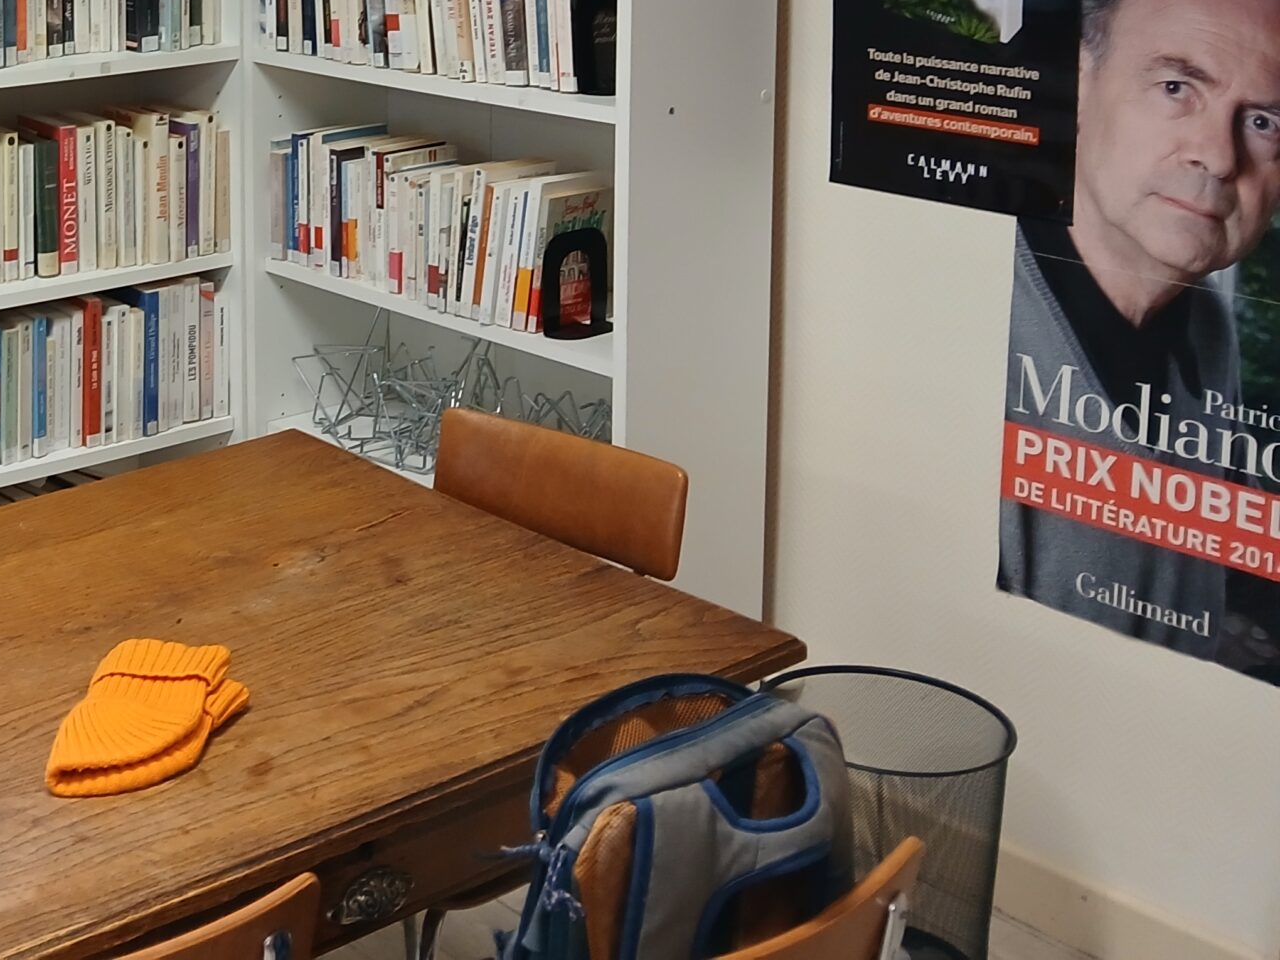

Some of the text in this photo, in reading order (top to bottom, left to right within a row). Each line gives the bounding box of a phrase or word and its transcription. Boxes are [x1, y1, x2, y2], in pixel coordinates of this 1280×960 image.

[488, 24, 496, 58] STEFAN
[867, 48, 1040, 81] Toute la puissance narrative
[875, 68, 1032, 100] de Jean-Christophe Rufin
[870, 107, 1038, 142] d'aventures contemporain.
[886, 90, 1018, 119] dans un grand roman
[907, 153, 988, 178] CALMANN
[157, 155, 167, 221] Jean Moulin
[63, 179, 76, 254] MONET
[188, 324, 197, 381] LES POMPIDOU
[1203, 388, 1280, 432] Patric
[1015, 429, 1118, 492] PRIX
[1014, 476, 1044, 503] DE
[1051, 486, 1223, 558] LITTÉRATURE
[1075, 571, 1211, 638] Gallimard
